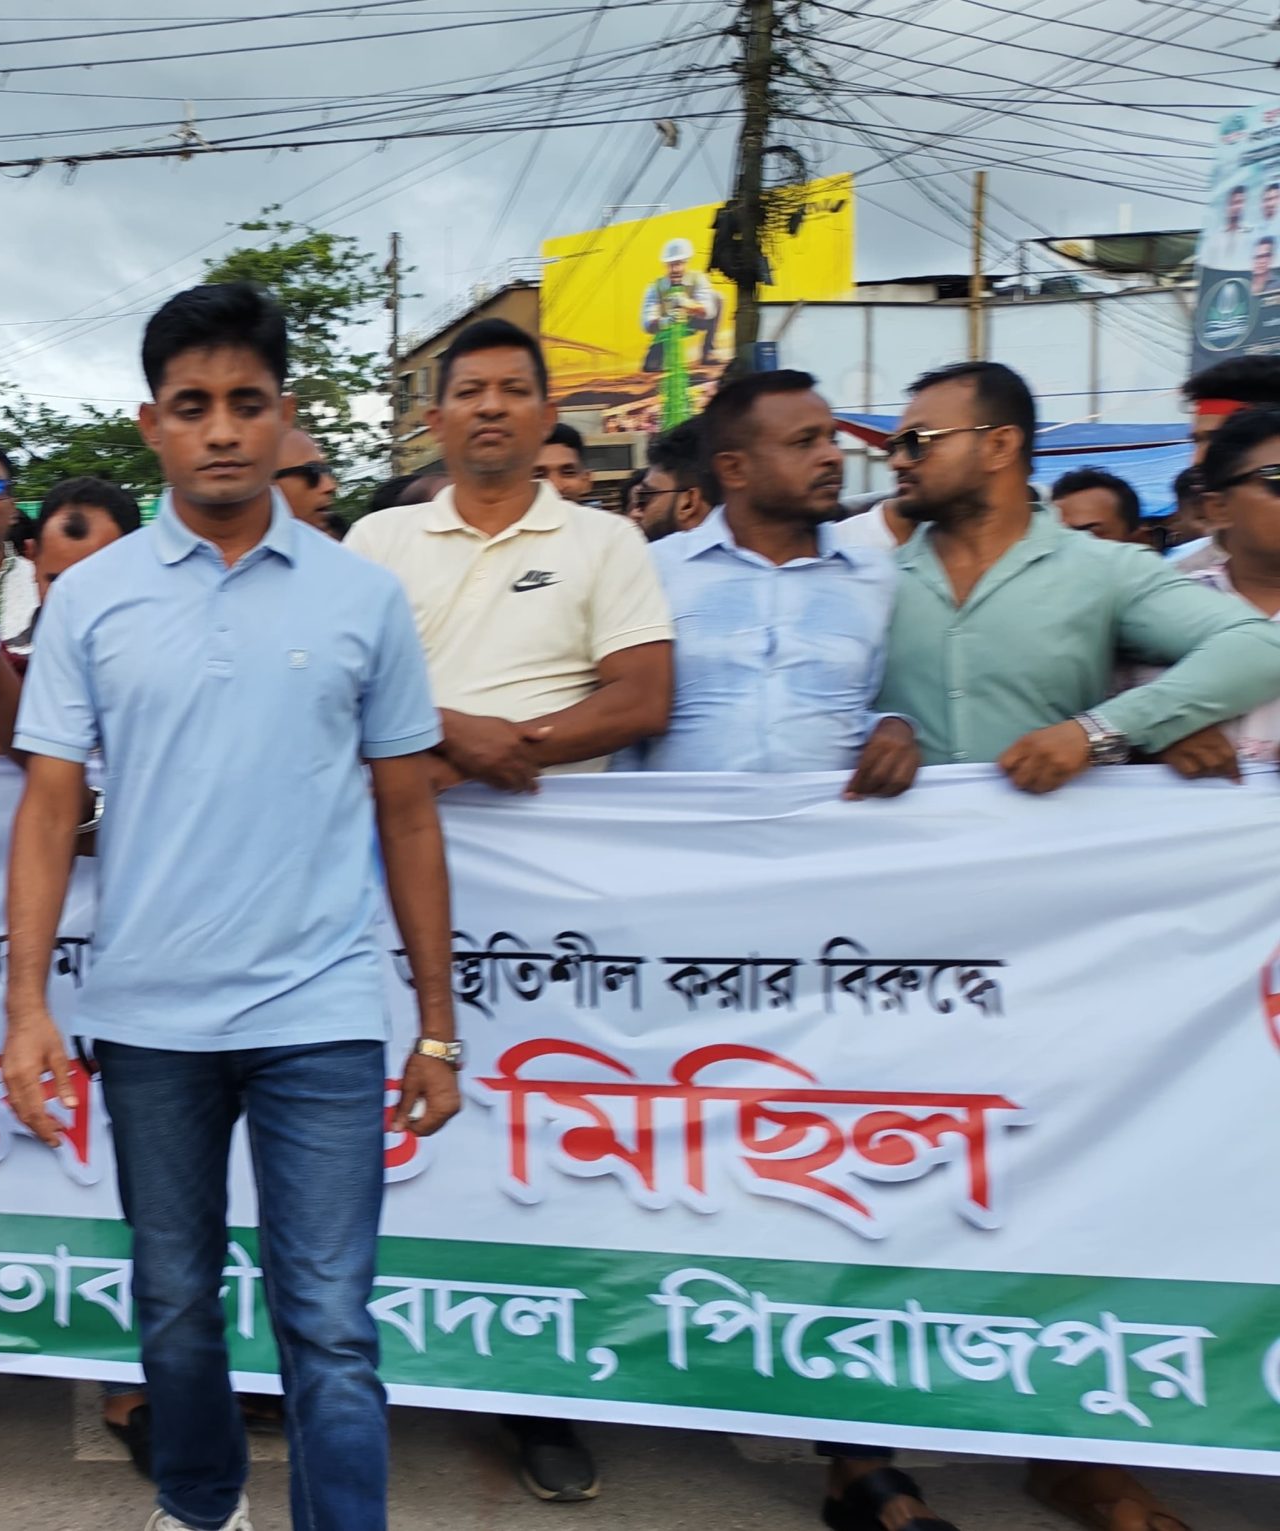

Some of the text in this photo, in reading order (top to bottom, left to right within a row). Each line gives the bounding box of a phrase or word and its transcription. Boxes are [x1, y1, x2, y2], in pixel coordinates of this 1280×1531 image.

[657, 952, 803, 1012] করার
[816, 936, 1009, 1017] বিরুদ্ধে
[475, 1038, 1022, 1219] মিছিল
[647, 1267, 1218, 1427] পিরোজপুর
